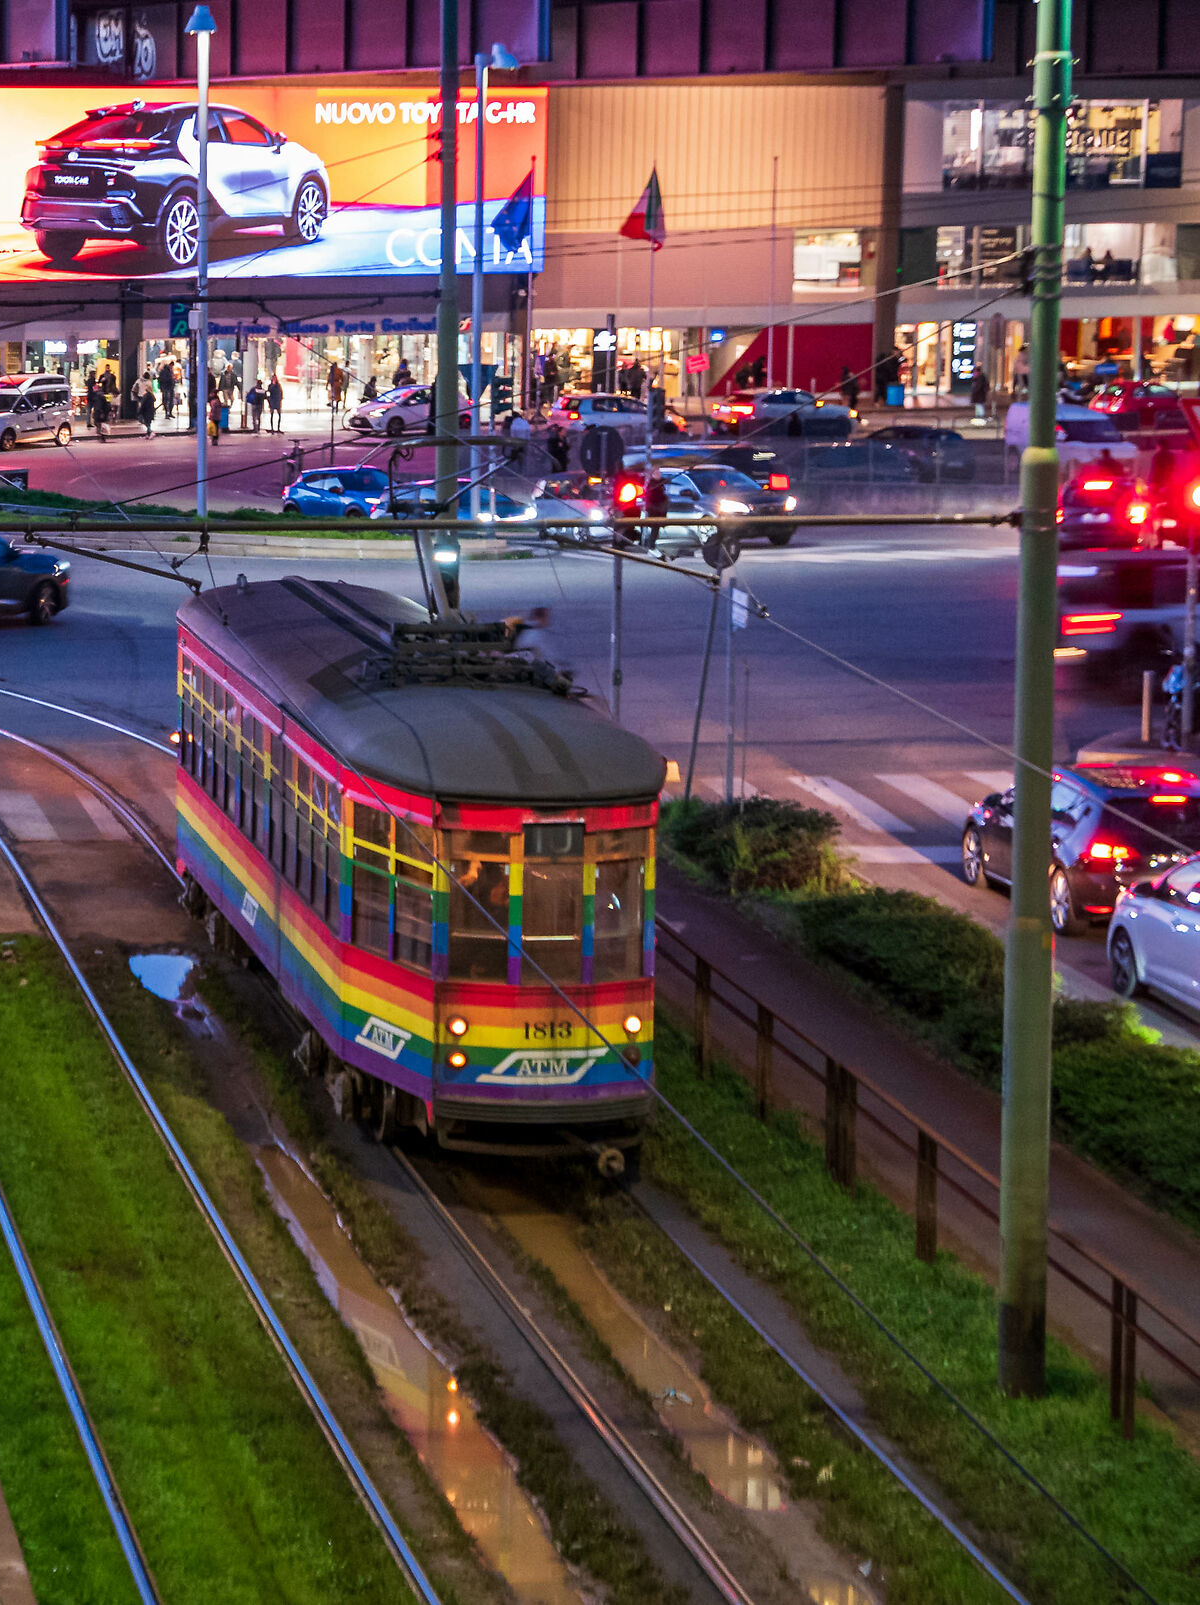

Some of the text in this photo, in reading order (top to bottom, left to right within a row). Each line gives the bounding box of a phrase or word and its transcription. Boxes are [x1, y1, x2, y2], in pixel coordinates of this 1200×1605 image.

[315, 101, 536, 124] NUOVO TOYTA C-HR
[335, 319, 376, 333] Porta
[372, 1025, 394, 1051] ATM
[524, 1021, 572, 1040] 1813
[516, 1058, 569, 1077] ATM
